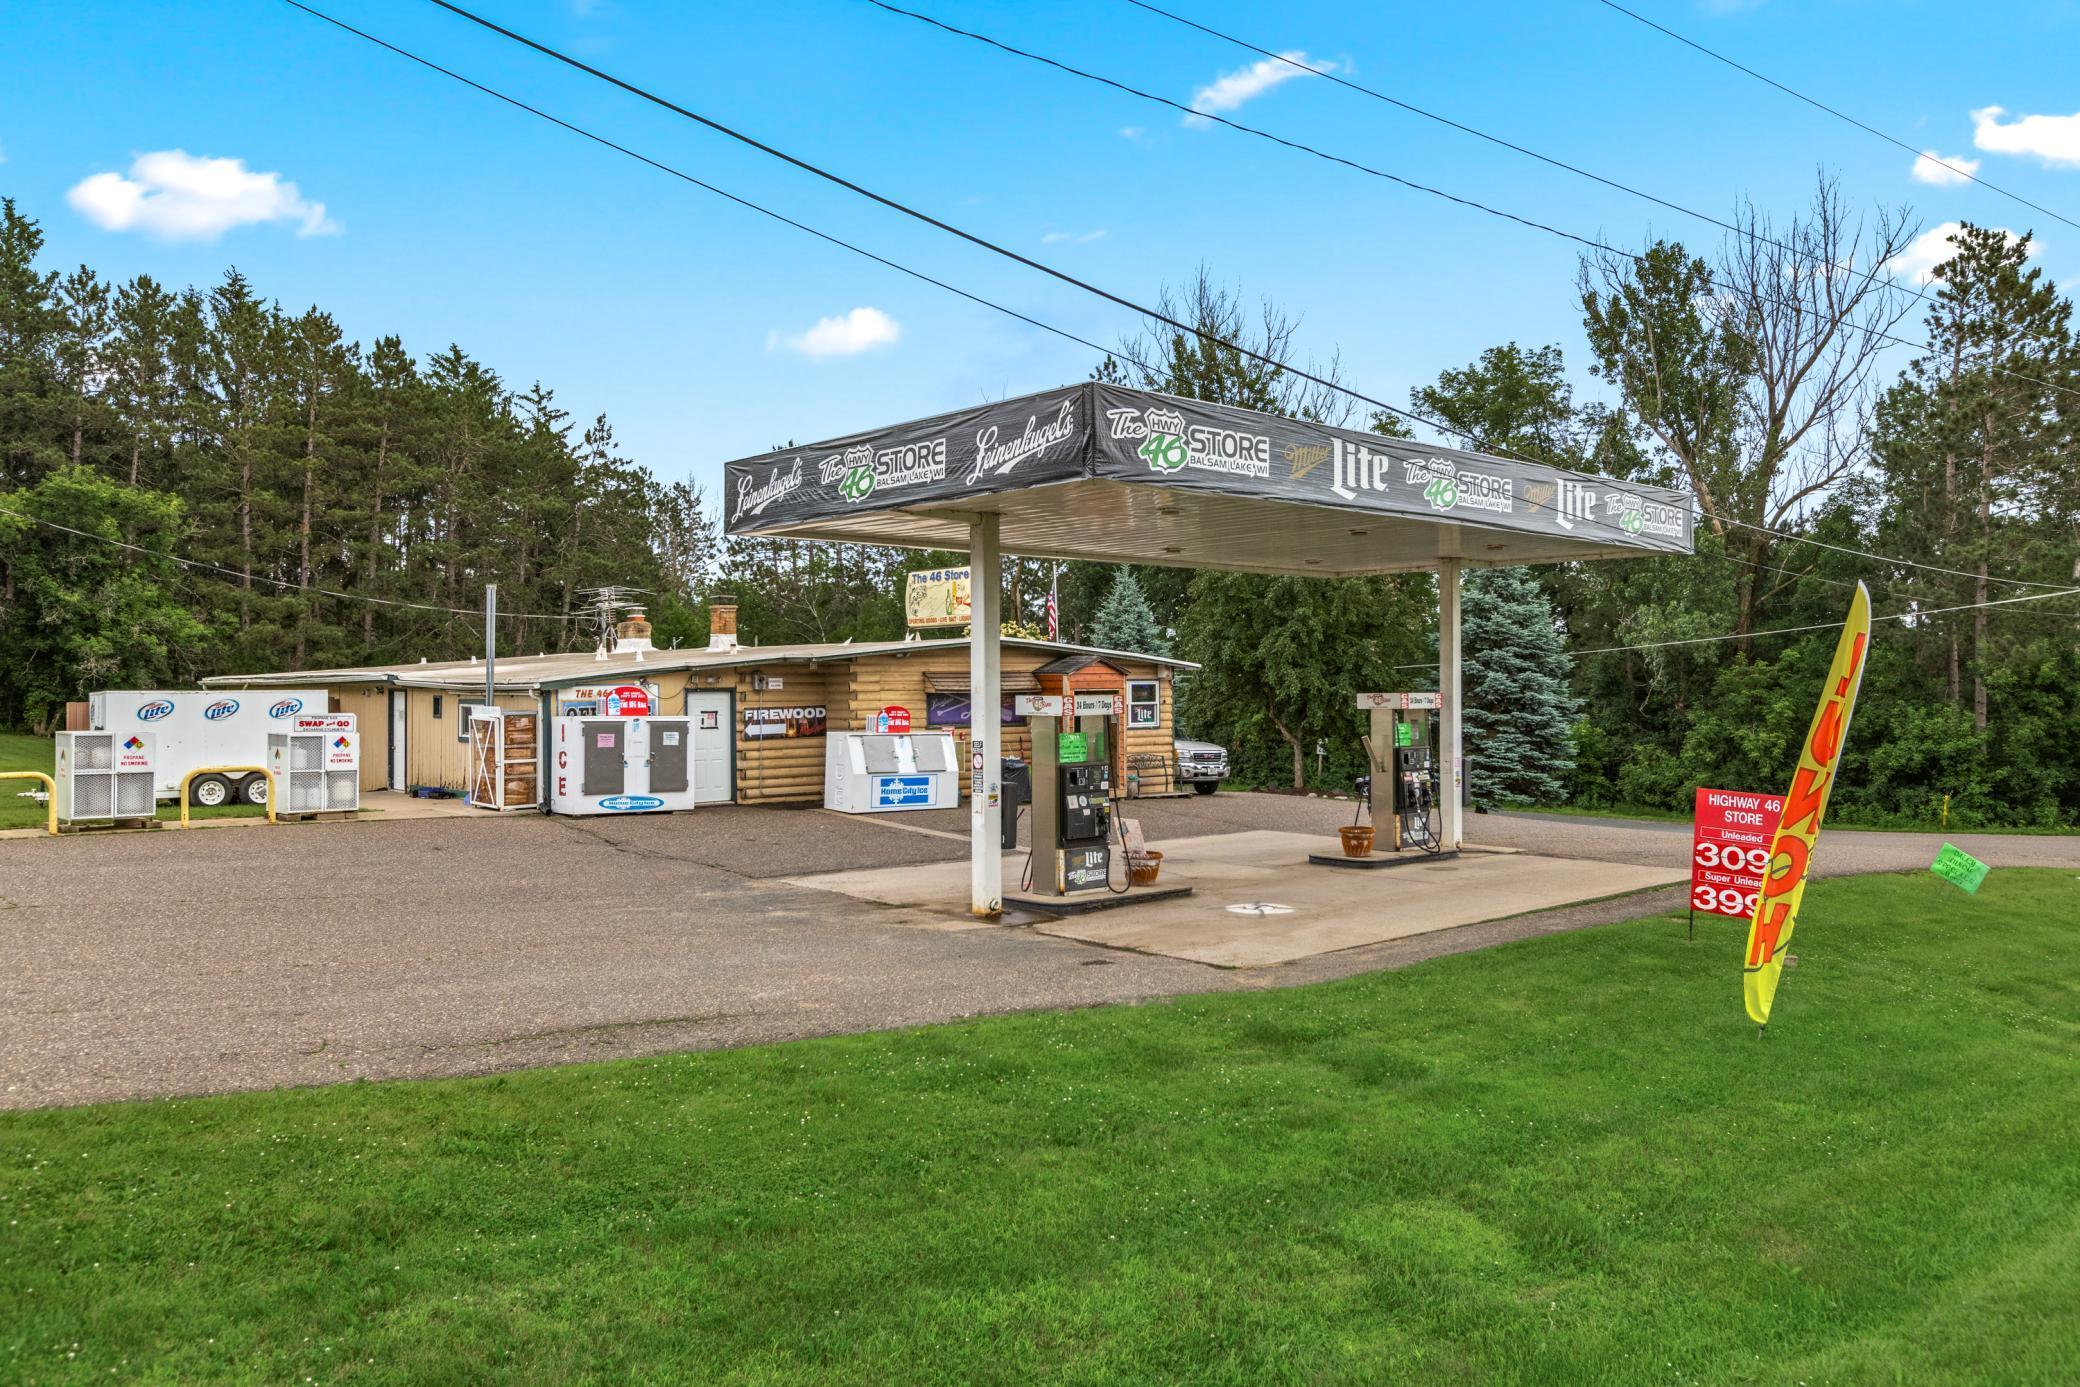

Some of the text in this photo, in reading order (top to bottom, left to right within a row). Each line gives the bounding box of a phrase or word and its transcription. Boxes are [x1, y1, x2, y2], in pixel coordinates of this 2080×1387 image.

[1107, 408, 1148, 439] The
[1151, 419, 1180, 434] HWY
[966, 400, 1075, 486] Leinenkugel's
[1139, 434, 1188, 469] 46
[1189, 426, 1269, 463] STORE
[848, 453, 870, 467] HWY
[876, 439, 946, 476] STORE
[1190, 455, 1228, 469] BALSAM
[1255, 465, 1268, 476] WI
[819, 455, 846, 484] The
[876, 473, 908, 488] BALSAM
[934, 466, 944, 478] WI
[1330, 437, 1390, 501] Lite
[1403, 459, 1431, 484] The
[731, 457, 803, 523] Leinenkugel's
[839, 464, 876, 499] 46
[1457, 472, 1512, 501] STORE
[1424, 478, 1458, 508] 46
[1458, 496, 1484, 507] BALSAM
[1555, 478, 1597, 530] Lite
[1604, 494, 1625, 515] The
[1619, 509, 1644, 534] 46
[1643, 504, 1683, 527] STORE
[912, 569, 970, 584] The 46 Store
[575, 690, 594, 698] THE
[1114, 695, 1124, 714] GAS
[143, 705, 170, 720] Lite
[211, 703, 235, 719] Lite
[275, 703, 298, 718] Lite
[745, 707, 827, 721] FIREWOOD
[1063, 696, 1074, 716] GAS
[1083, 701, 1095, 709] Hours
[1137, 708, 1152, 721] Lite
[558, 723, 568, 797] ICE
[881, 786, 928, 796] Home City Ice
[1708, 794, 1781, 812] HIGHWAY 46
[1724, 810, 1764, 825] STORE
[1721, 830, 1763, 843] Unleaded
[1085, 851, 1103, 868] Lite
[1695, 842, 1770, 874] 309
[1705, 872, 1762, 888] Super Unlea
